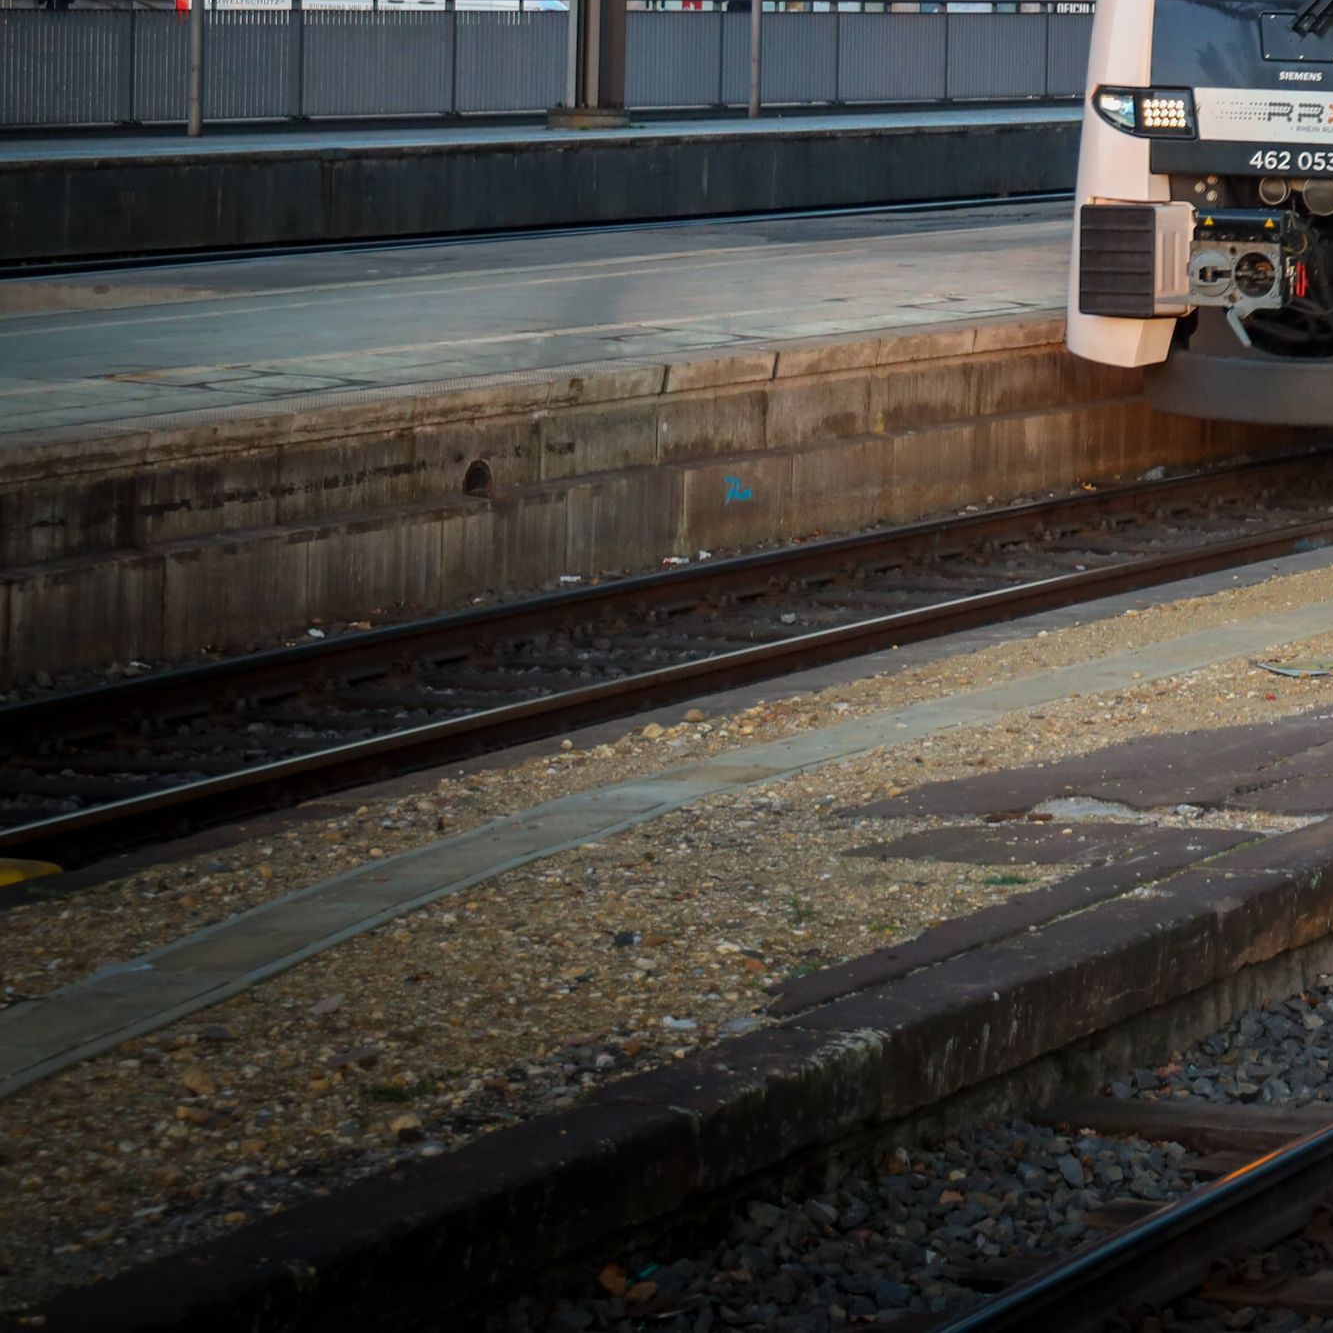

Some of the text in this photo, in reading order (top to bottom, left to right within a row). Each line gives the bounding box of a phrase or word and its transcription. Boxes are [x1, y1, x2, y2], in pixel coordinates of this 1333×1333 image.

[1279, 70, 1323, 82] SIEMENS
[1296, 125, 1320, 134] RHEIN
[1249, 150, 1291, 170] 462
